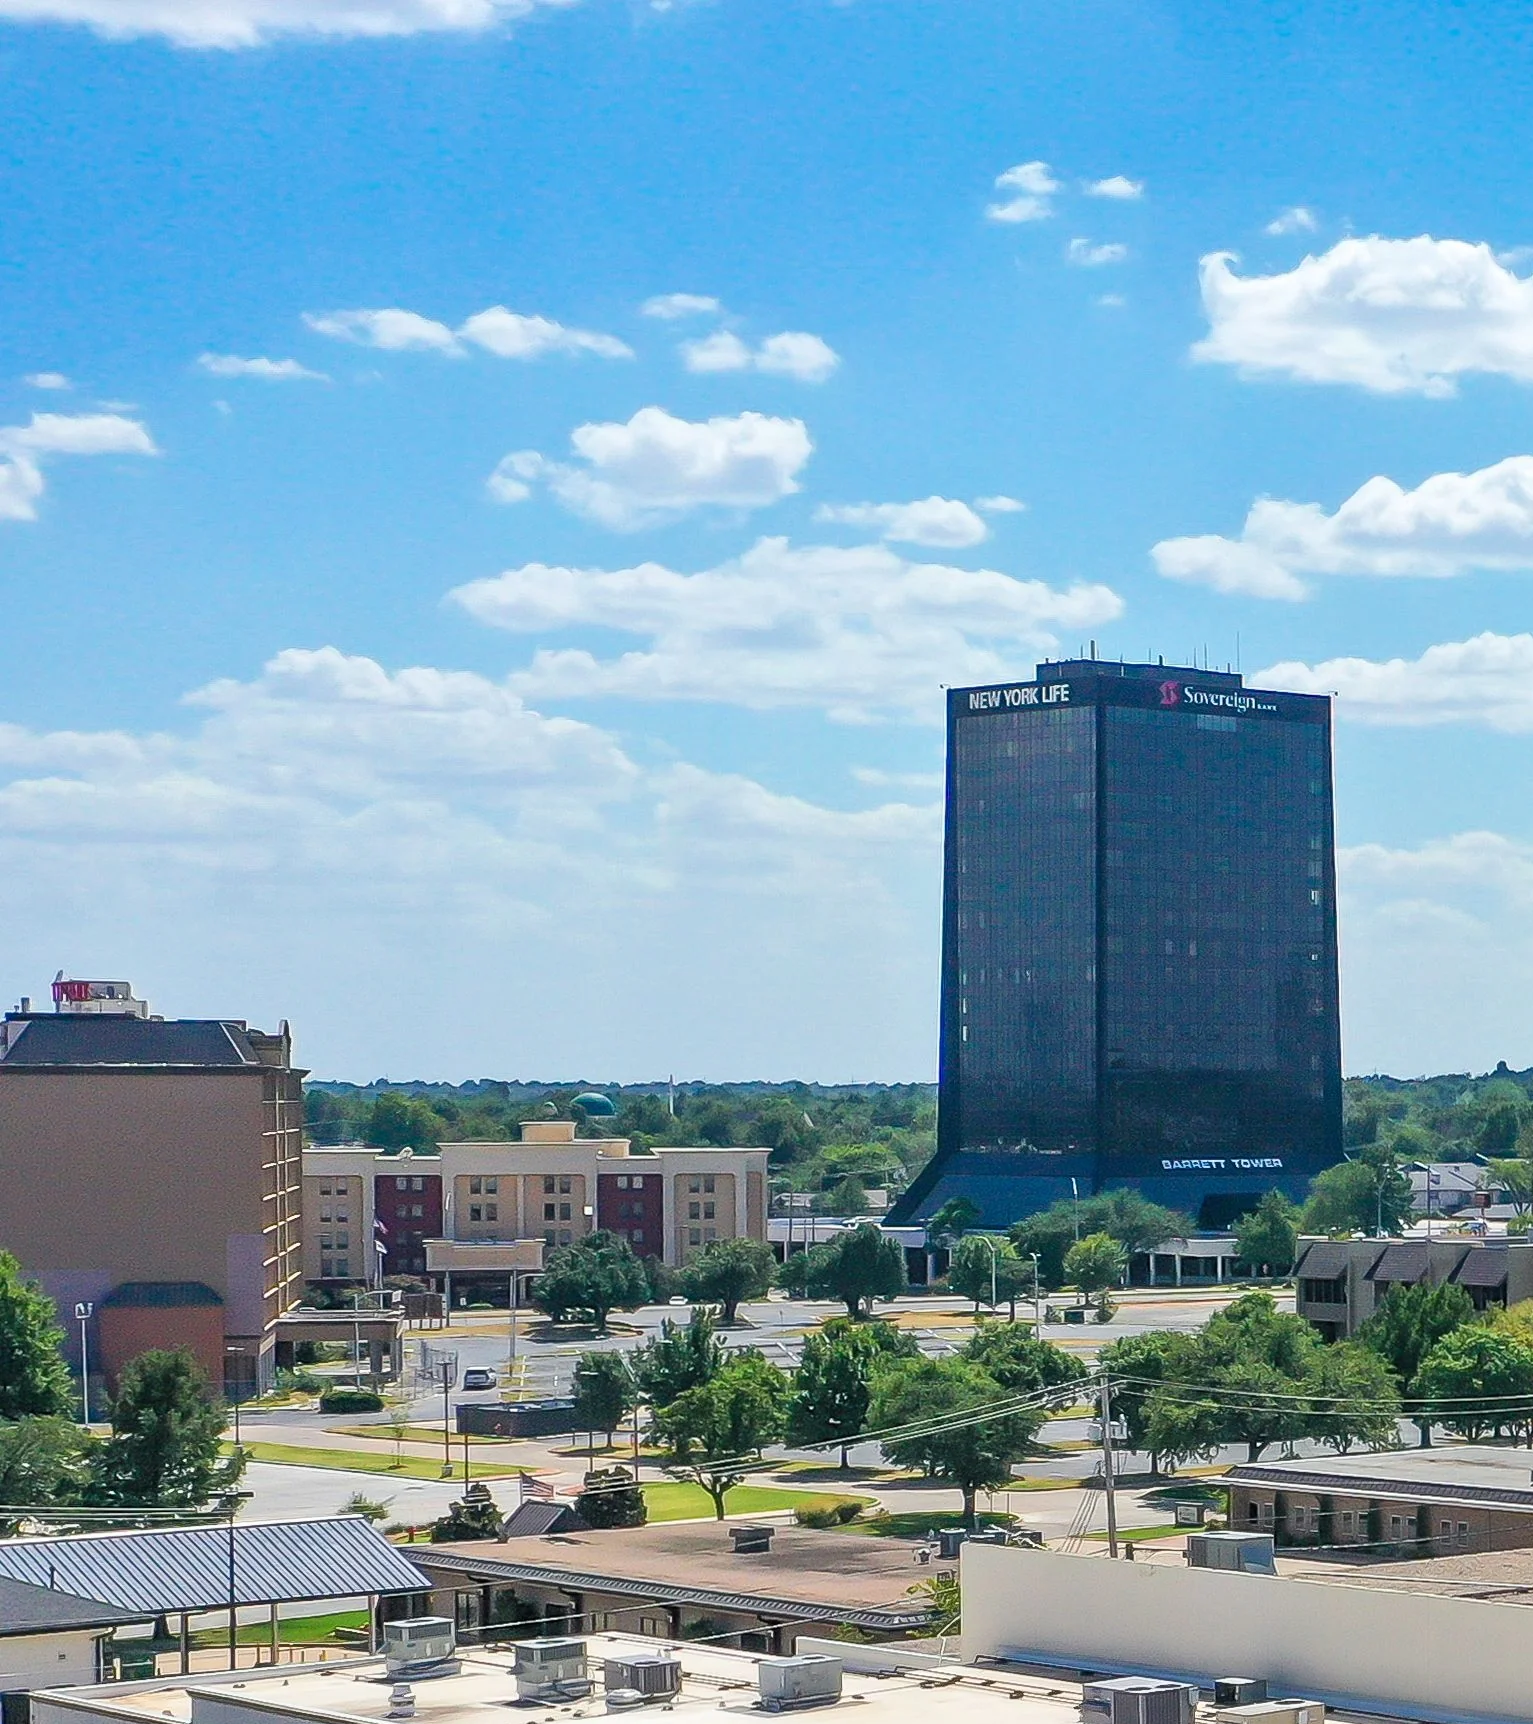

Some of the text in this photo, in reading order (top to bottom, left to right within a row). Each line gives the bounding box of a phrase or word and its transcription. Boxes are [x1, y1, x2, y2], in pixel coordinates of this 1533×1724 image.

[969, 684, 1070, 710] NEW YORK LIFE
[1184, 686, 1256, 713] Sovereign
[1161, 1158, 1283, 1170] BARRETT TOWER
